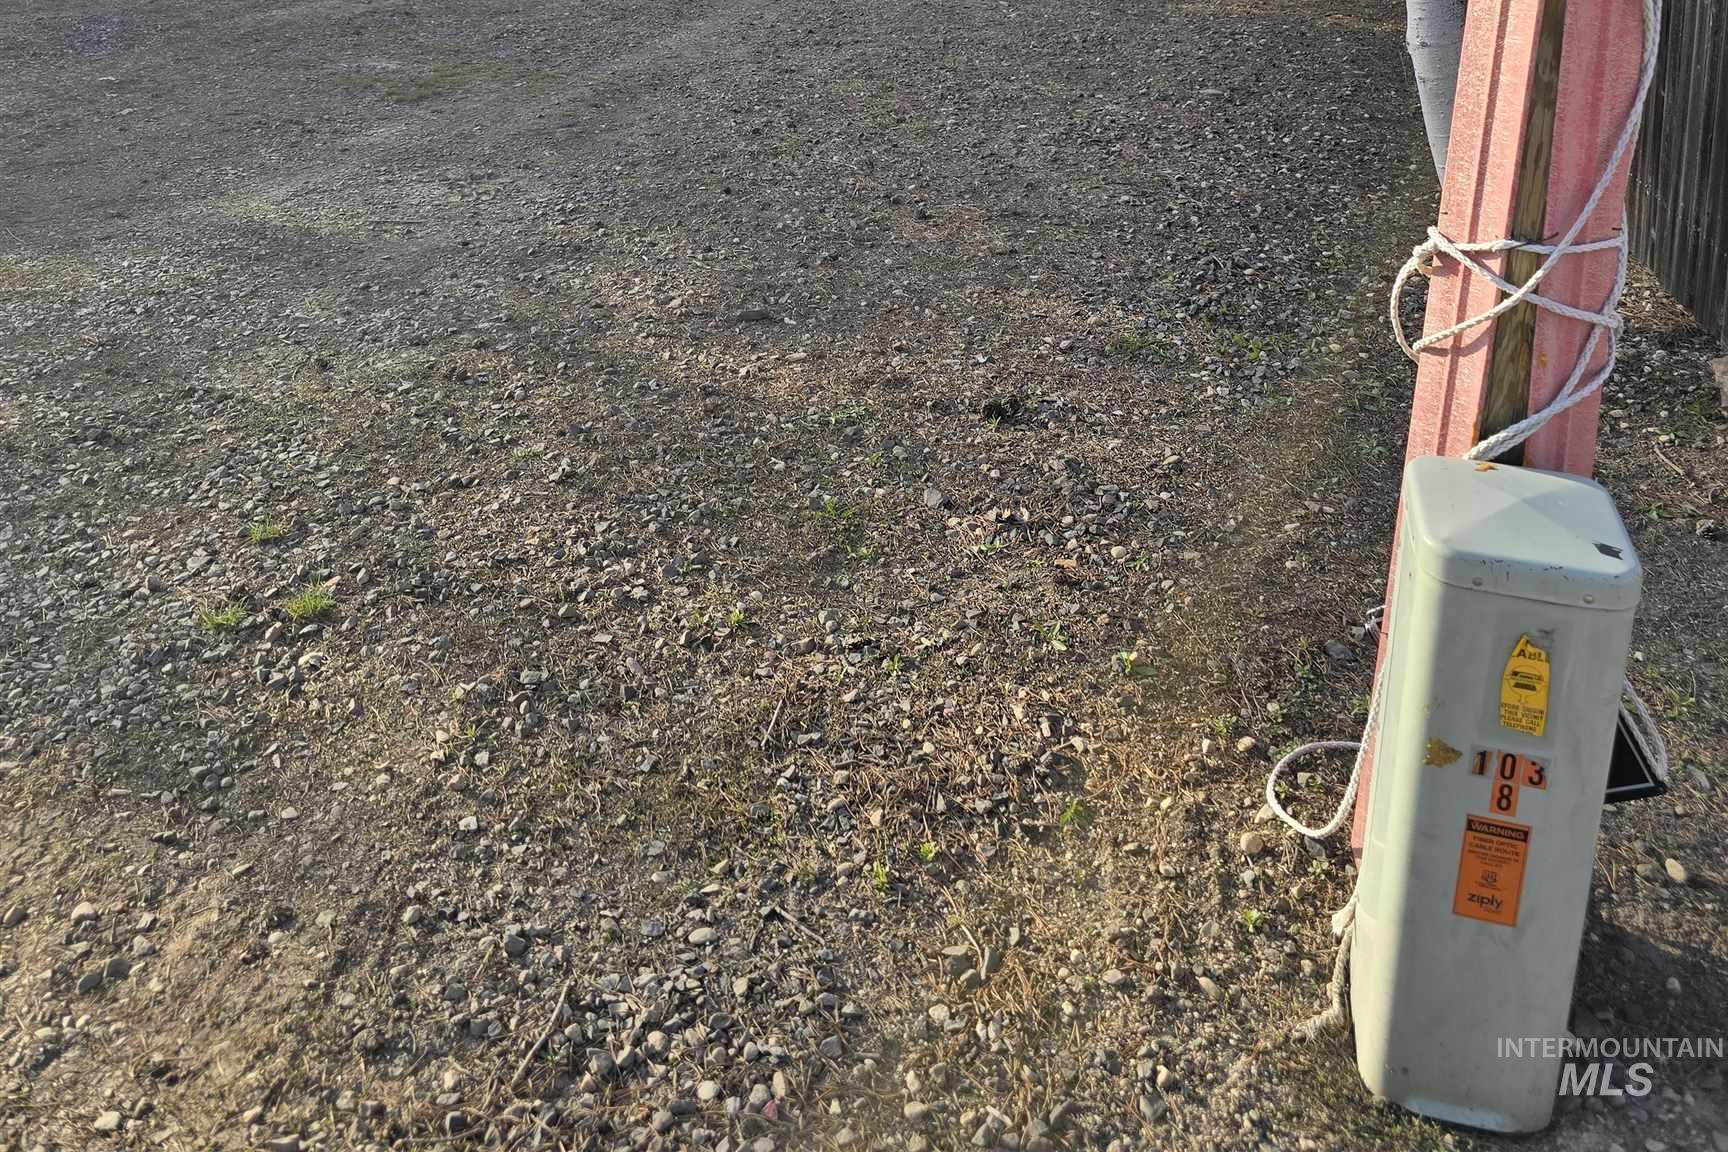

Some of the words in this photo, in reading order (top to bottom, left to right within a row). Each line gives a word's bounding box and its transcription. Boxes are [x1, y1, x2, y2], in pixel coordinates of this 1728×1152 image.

[1496, 783, 1513, 812] 8
[1471, 821, 1525, 840] WARNING
[1467, 892, 1503, 910] ziply
